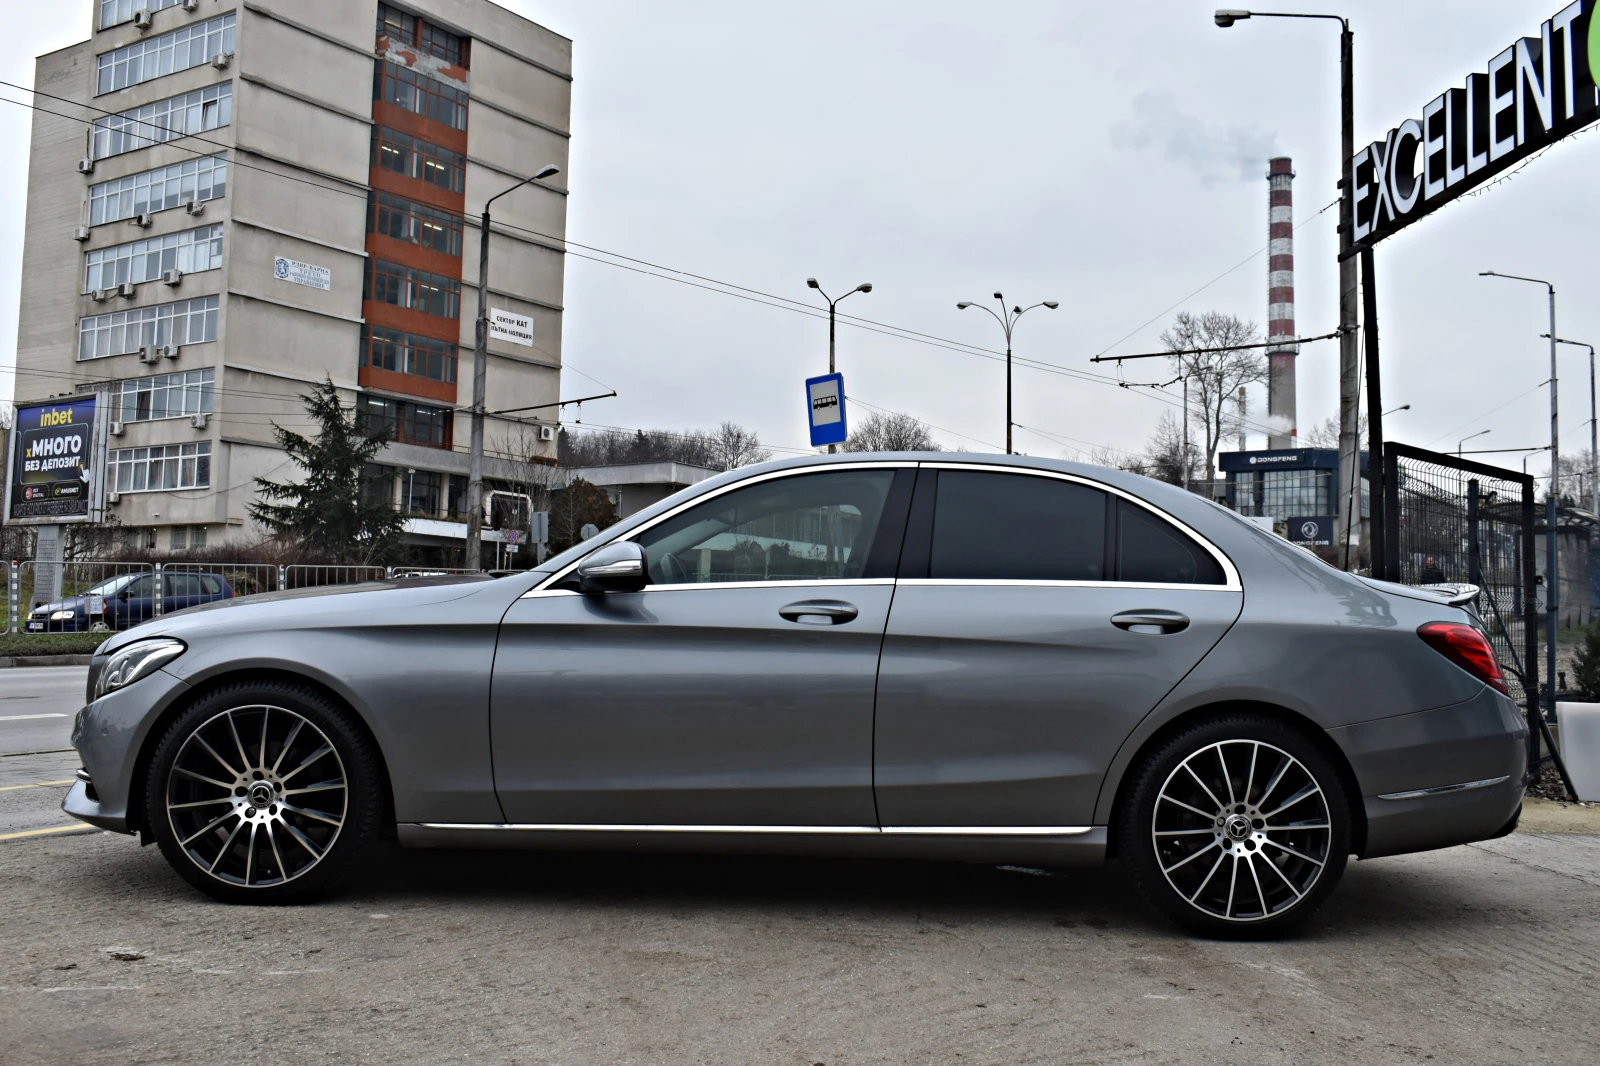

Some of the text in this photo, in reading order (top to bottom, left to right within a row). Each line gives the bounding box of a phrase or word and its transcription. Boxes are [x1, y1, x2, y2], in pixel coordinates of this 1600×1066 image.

[1353, 0, 1581, 243] EXCELLENT
[497, 315, 528, 328] СЕКТОР КАТ
[508, 330, 532, 340] ПОЛИЦИЯ
[40, 407, 73, 427] inbet
[25, 456, 80, 472] БЕЗ ДЕПОЗИТ
[1257, 455, 1298, 463] DONGFENG
